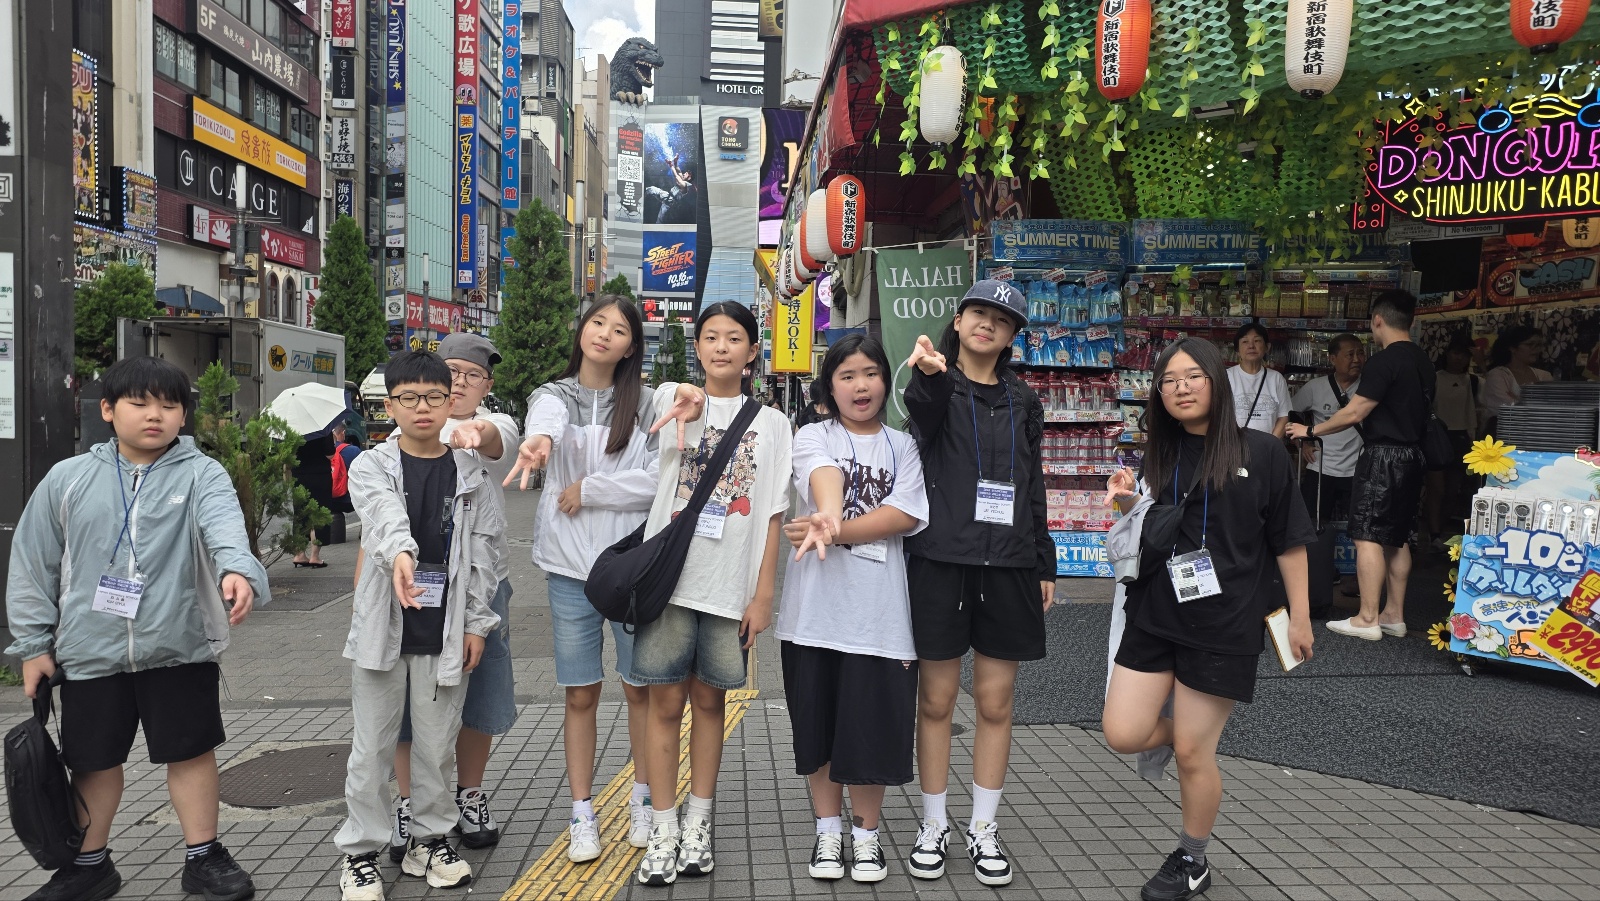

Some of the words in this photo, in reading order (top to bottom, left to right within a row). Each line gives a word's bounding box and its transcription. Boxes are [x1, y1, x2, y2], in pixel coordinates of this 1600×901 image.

[200, 5, 217, 30] 5F
[1302, 0, 1328, 75] 新宿歌舞伎町
[251, 39, 294, 87] 山内農場
[1102, 18, 1120, 87] 新宿歌舞伎町
[716, 84, 748, 94] HOTEL
[749, 85, 764, 95] GR
[194, 112, 231, 139] TORIKIZOKU
[1378, 132, 1491, 189] DON
[1493, 121, 1600, 178] QUI
[460, 133, 473, 205] マツモトキヨシ
[1462, 224, 1493, 233] Restroom
[261, 229, 288, 257] さかい
[643, 243, 685, 262] STREET
[1003, 232, 1079, 248] SUMMER
[1080, 233, 1120, 250] TIME
[1144, 233, 1219, 249] SUMMER
[1220, 233, 1260, 249] TIME
[650, 250, 695, 271] FIGHTER
[407, 301, 449, 327] ラオ歌広場
[658, 301, 692, 310] MRUHAN
[293, 354, 312, 370] クール
[1070, 546, 1109, 562] TIME
